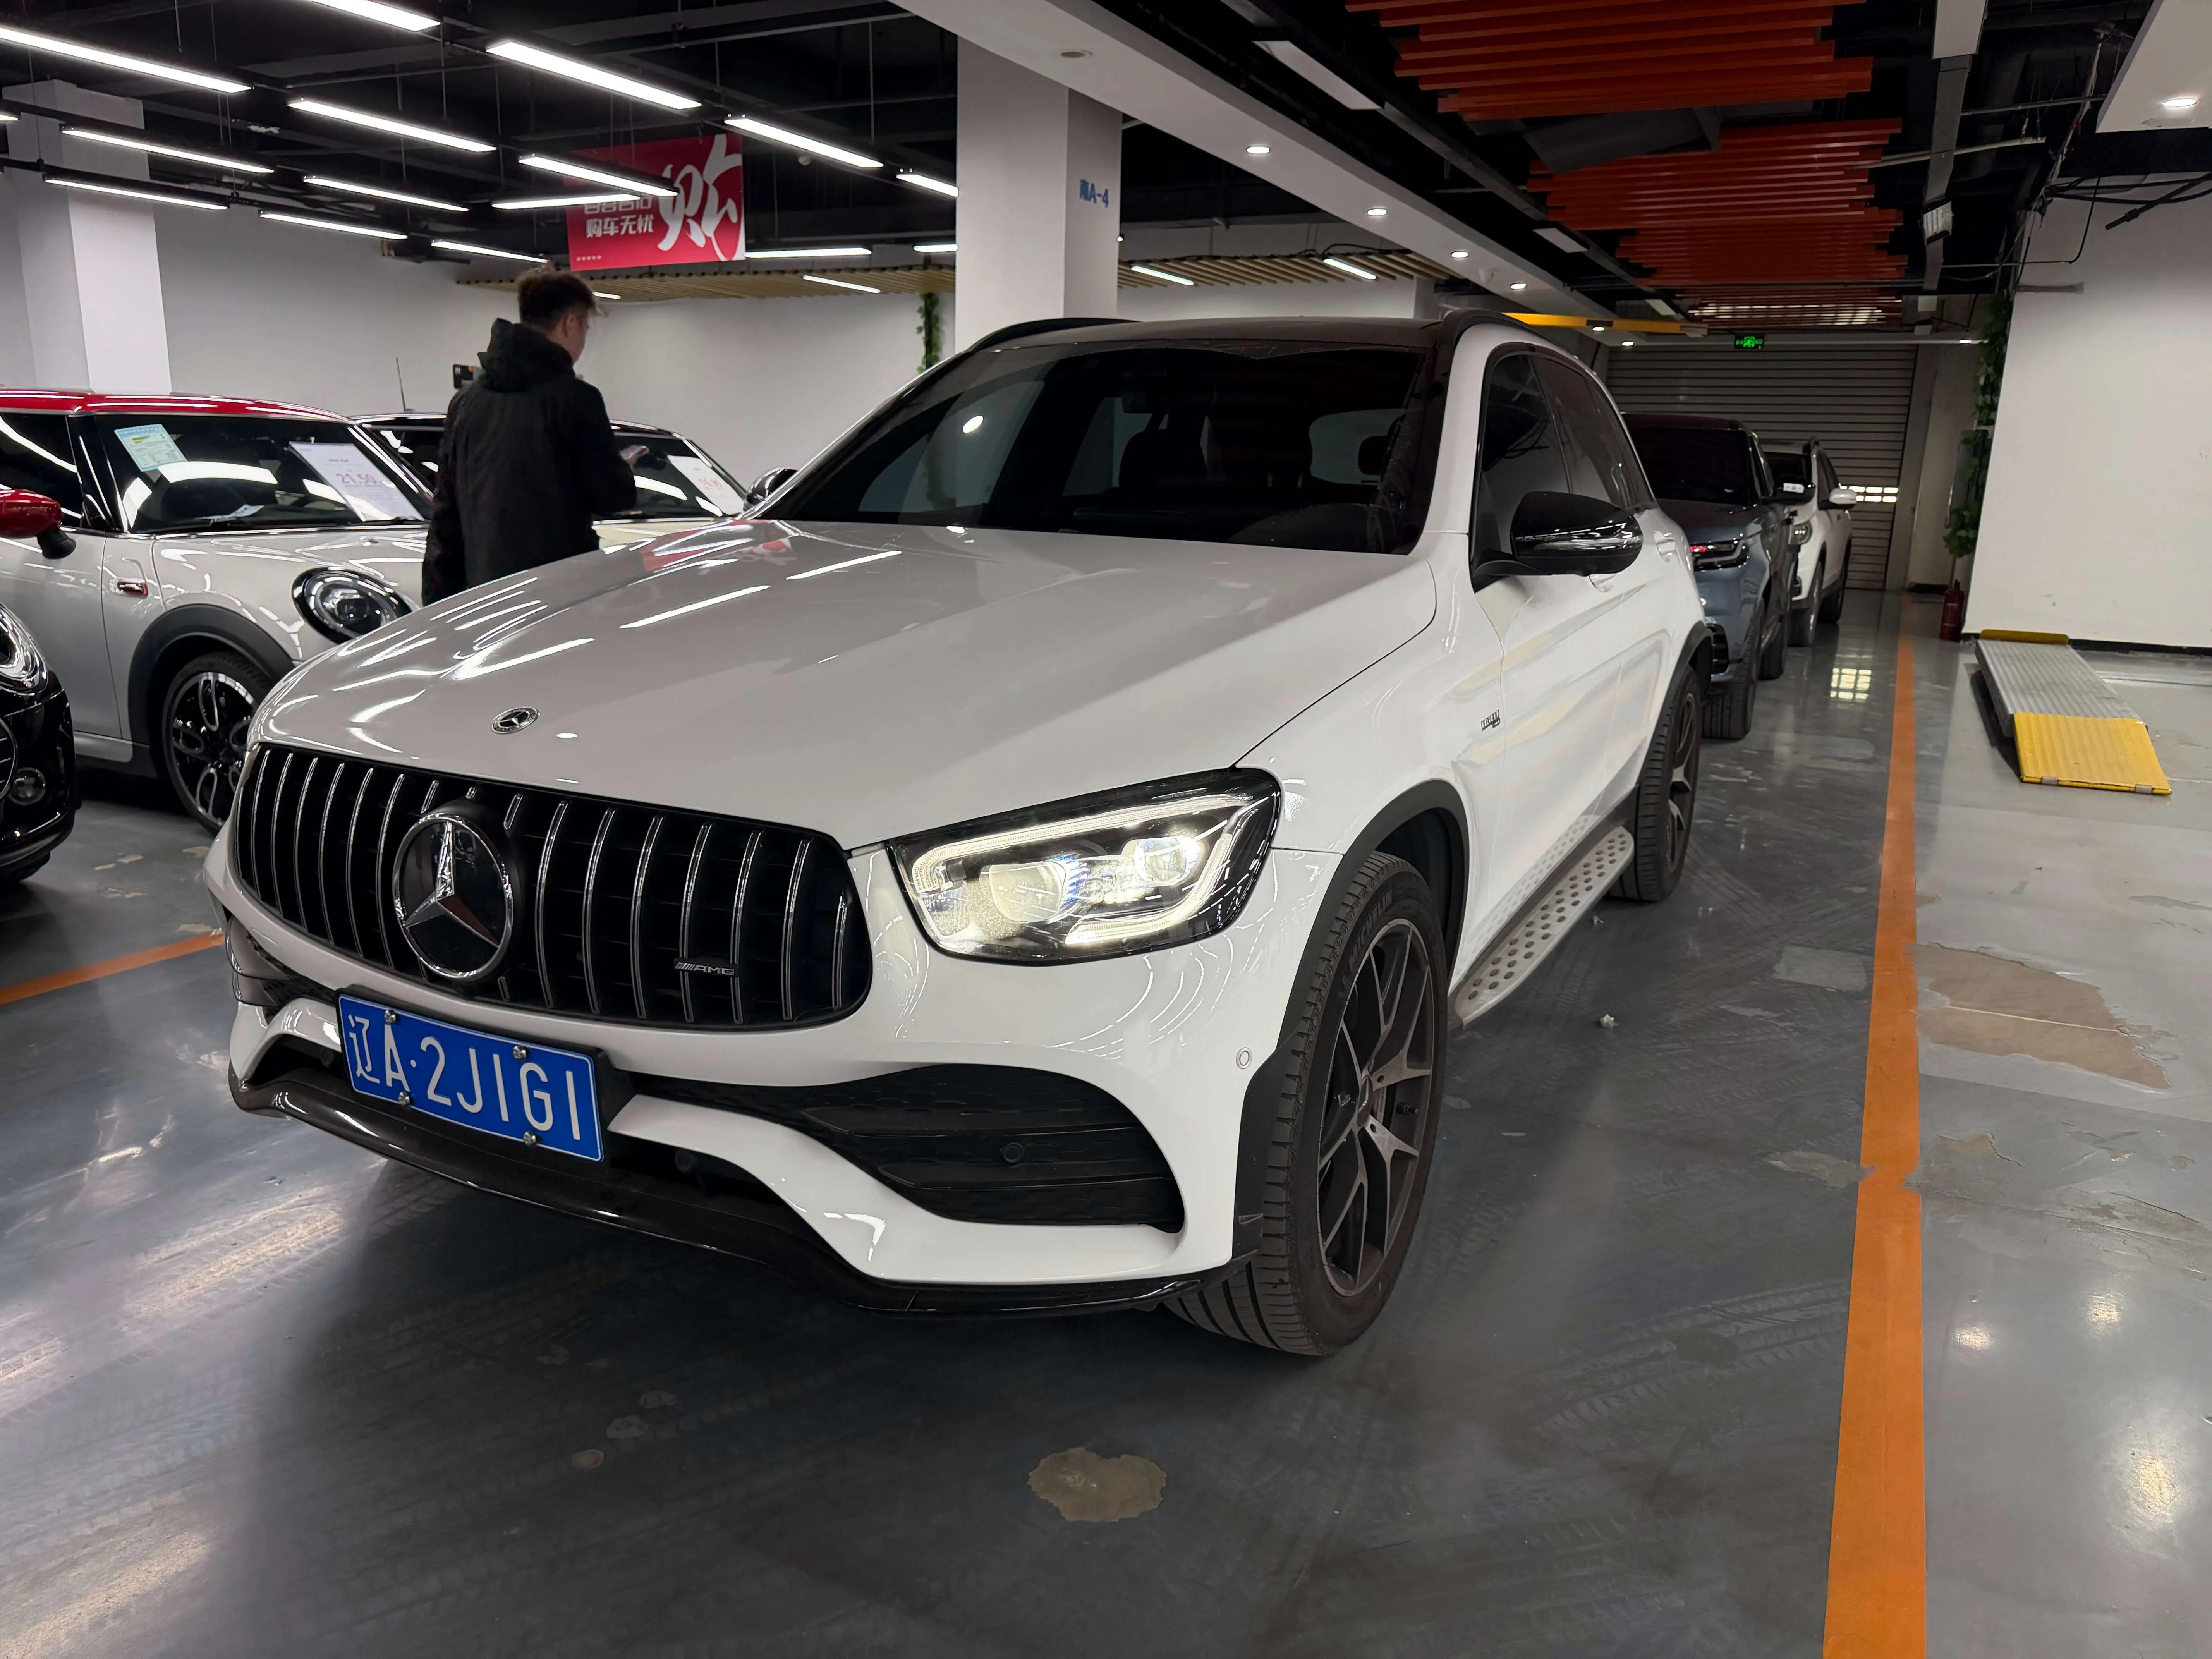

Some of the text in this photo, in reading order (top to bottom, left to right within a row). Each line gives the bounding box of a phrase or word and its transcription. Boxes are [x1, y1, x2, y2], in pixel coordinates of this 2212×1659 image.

[586, 214, 654, 238] 购车无忧
[1348, 889, 1393, 970] MICHELIN
[694, 964, 734, 976] AMG
